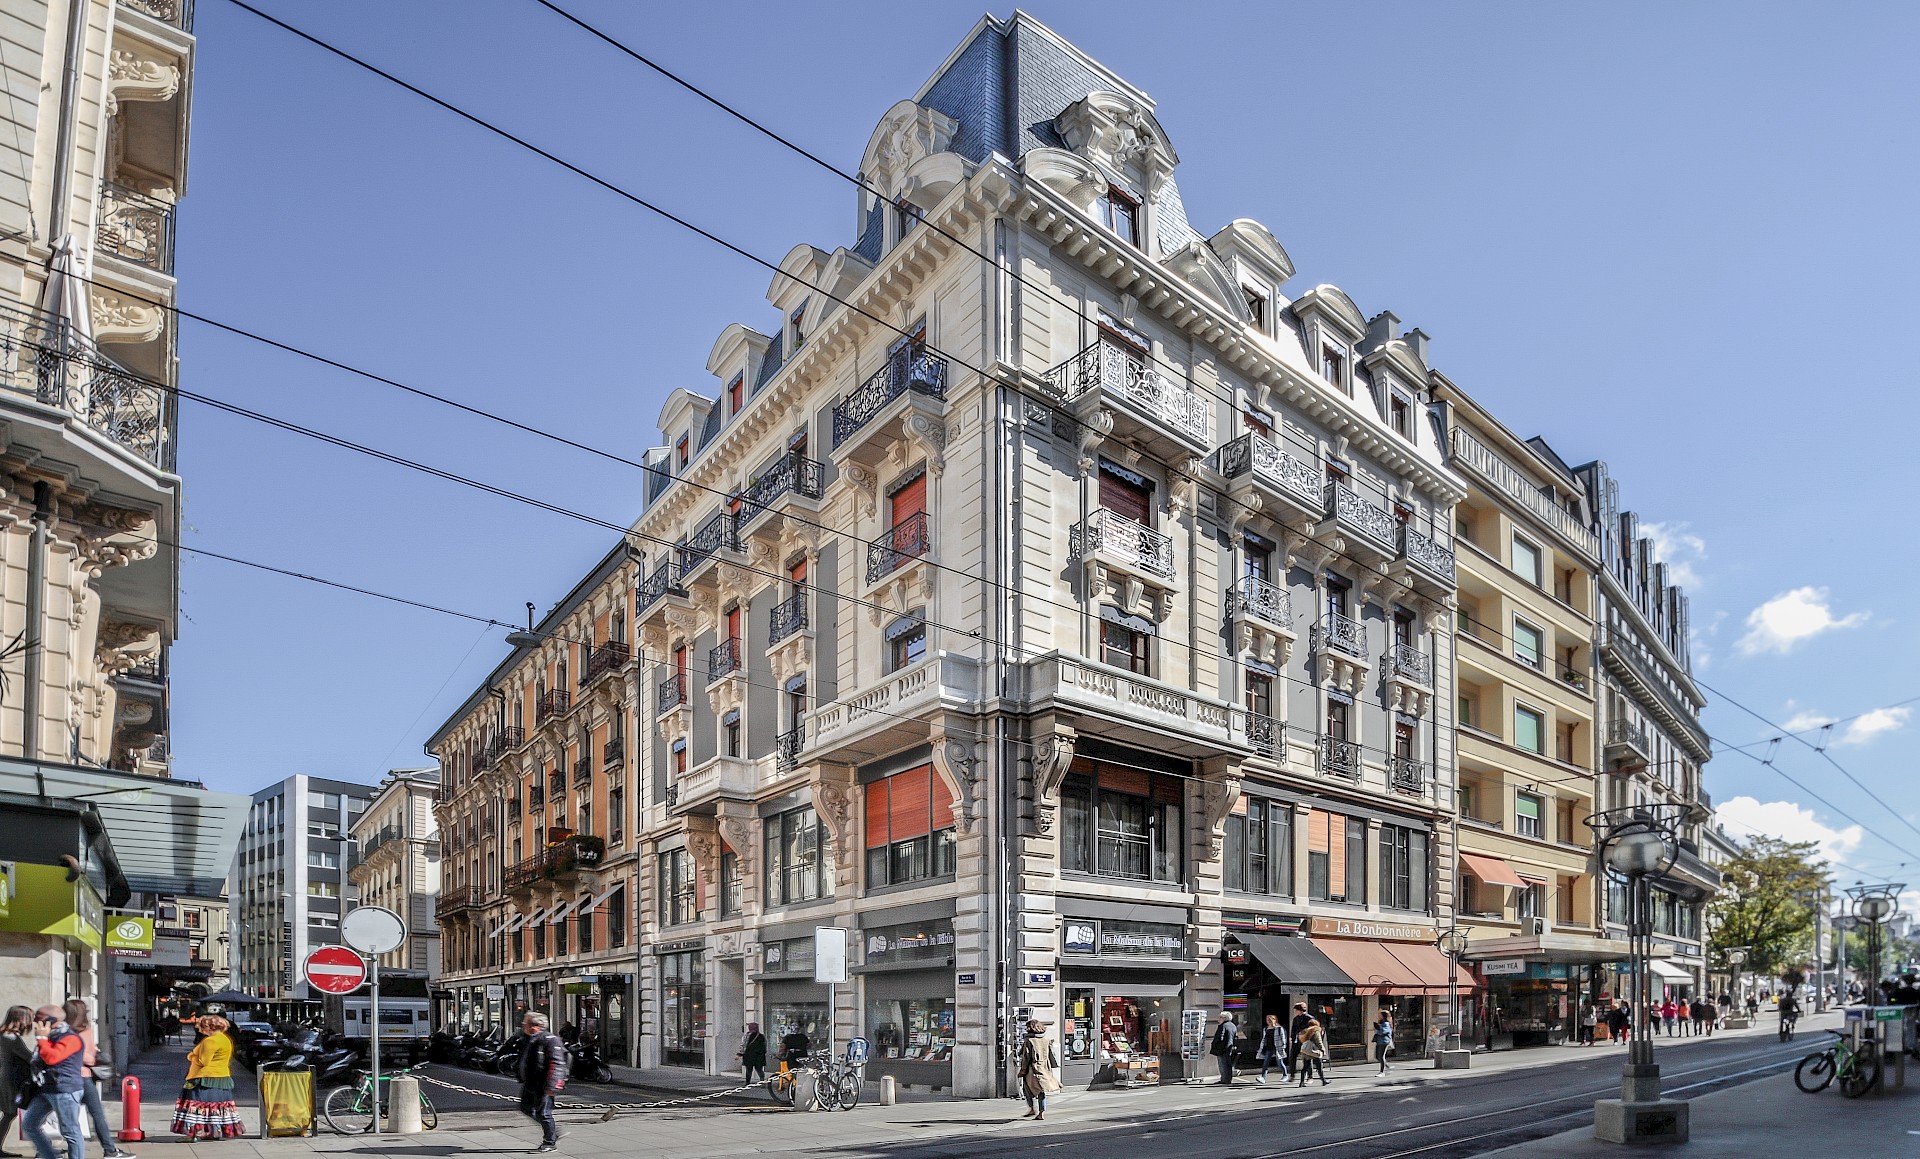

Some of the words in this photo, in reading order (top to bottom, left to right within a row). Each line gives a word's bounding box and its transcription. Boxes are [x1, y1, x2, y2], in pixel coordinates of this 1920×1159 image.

[1254, 914, 1268, 925] ice
[1336, 920, 1351, 934] La
[1352, 922, 1421, 938] Bonbonnière
[888, 940, 896, 950] La
[897, 938, 919, 949] Maison
[919, 937, 928, 947] de
[929, 934, 936, 946] la
[937, 932, 954, 945] Bible
[1102, 934, 1112, 945] La
[1113, 934, 1142, 946] Maison
[1143, 936, 1153, 946] de
[1154, 937, 1162, 947] la
[1163, 937, 1181, 948] Bible
[1507, 962, 1518, 970] TEA
